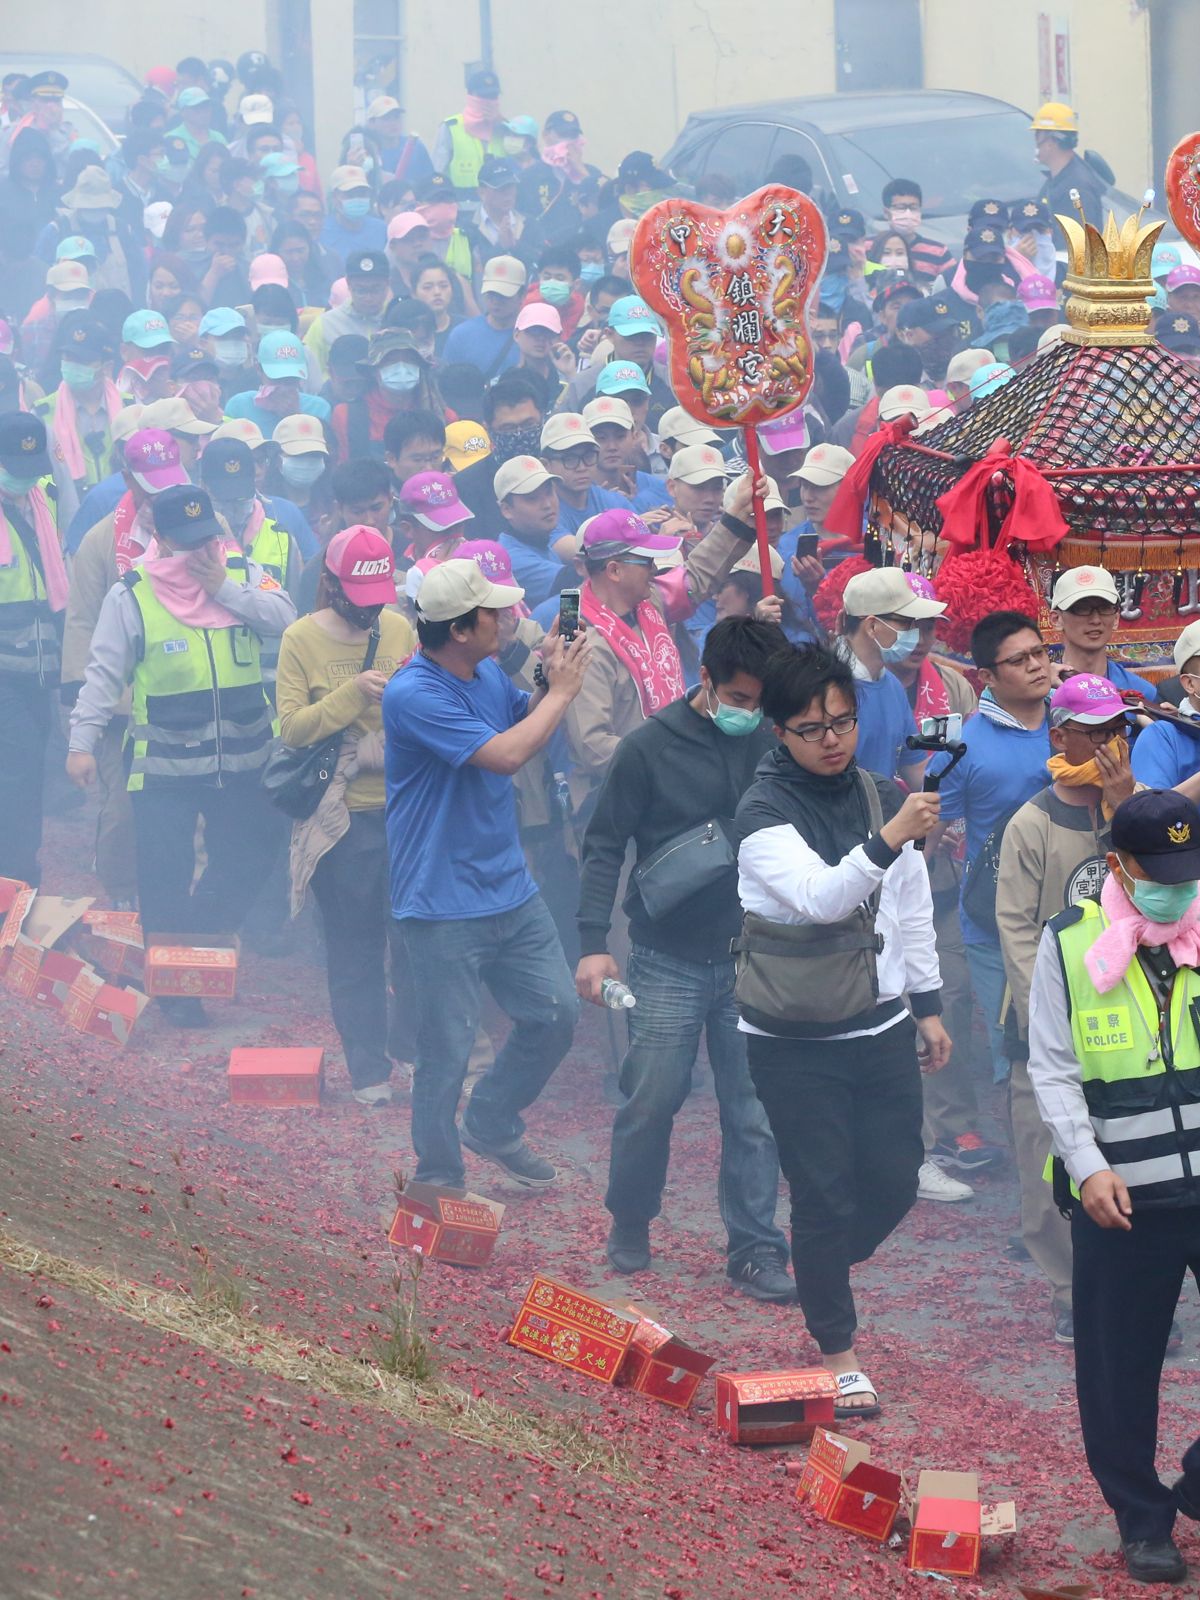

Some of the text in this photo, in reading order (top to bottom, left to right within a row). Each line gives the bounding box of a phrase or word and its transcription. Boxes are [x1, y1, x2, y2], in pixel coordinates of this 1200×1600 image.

[669, 208, 793, 256] 大 甲
[726, 271, 763, 386] 鎮瀾宮
[1086, 1013, 1120, 1031] 警察
[1086, 1033, 1127, 1046] POLICE
[839, 1374, 860, 1385] NIKE
